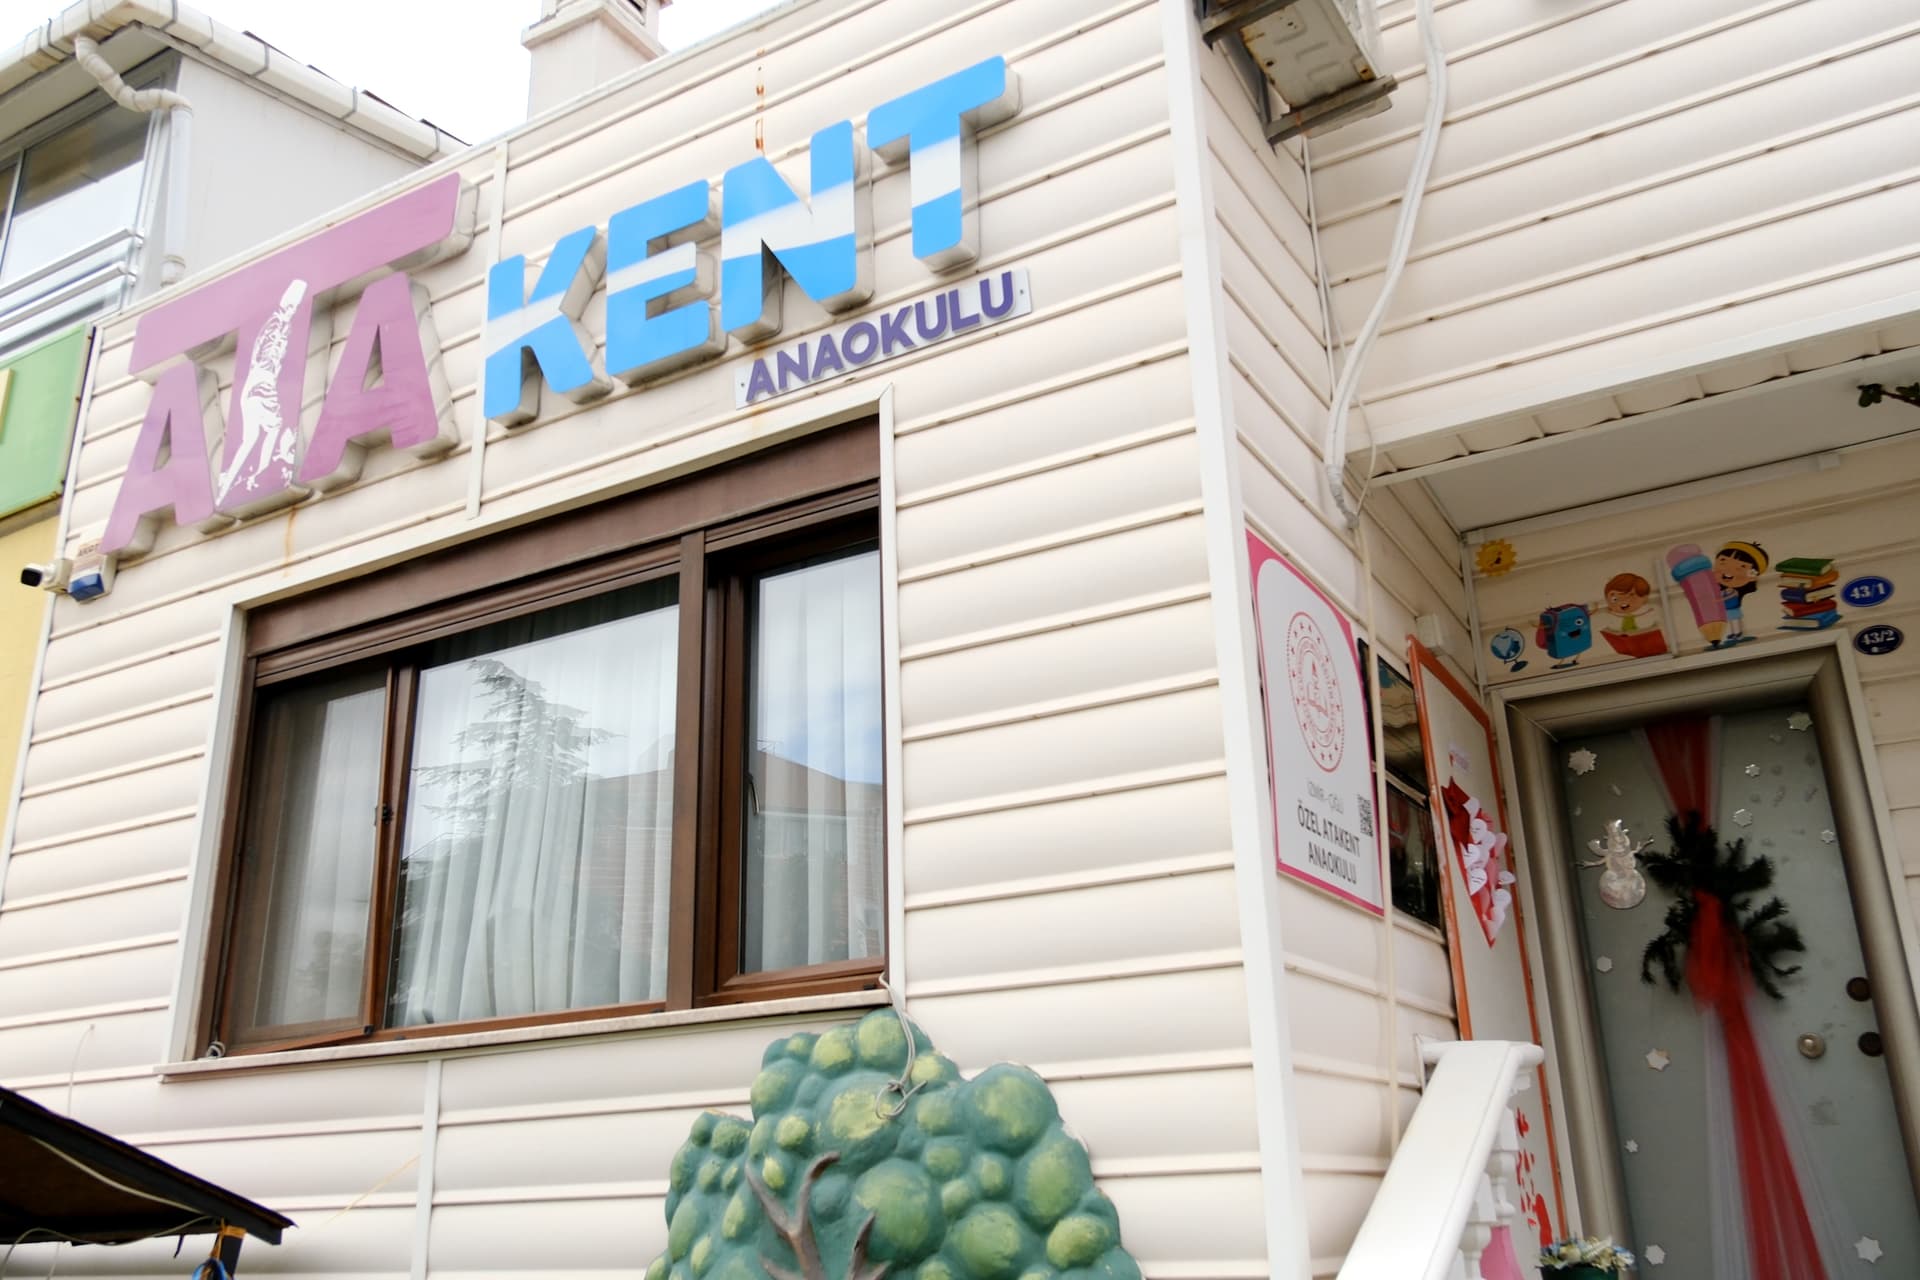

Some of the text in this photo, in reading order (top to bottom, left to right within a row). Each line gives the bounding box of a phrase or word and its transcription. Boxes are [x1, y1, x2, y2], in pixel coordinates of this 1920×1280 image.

[747, 271, 1015, 403] ANAOKULU
[1850, 582, 1885, 599] 43/1
[1297, 797, 1360, 858] ÖZEL ATAKENT
[1309, 841, 1357, 885] ANAOKULU
